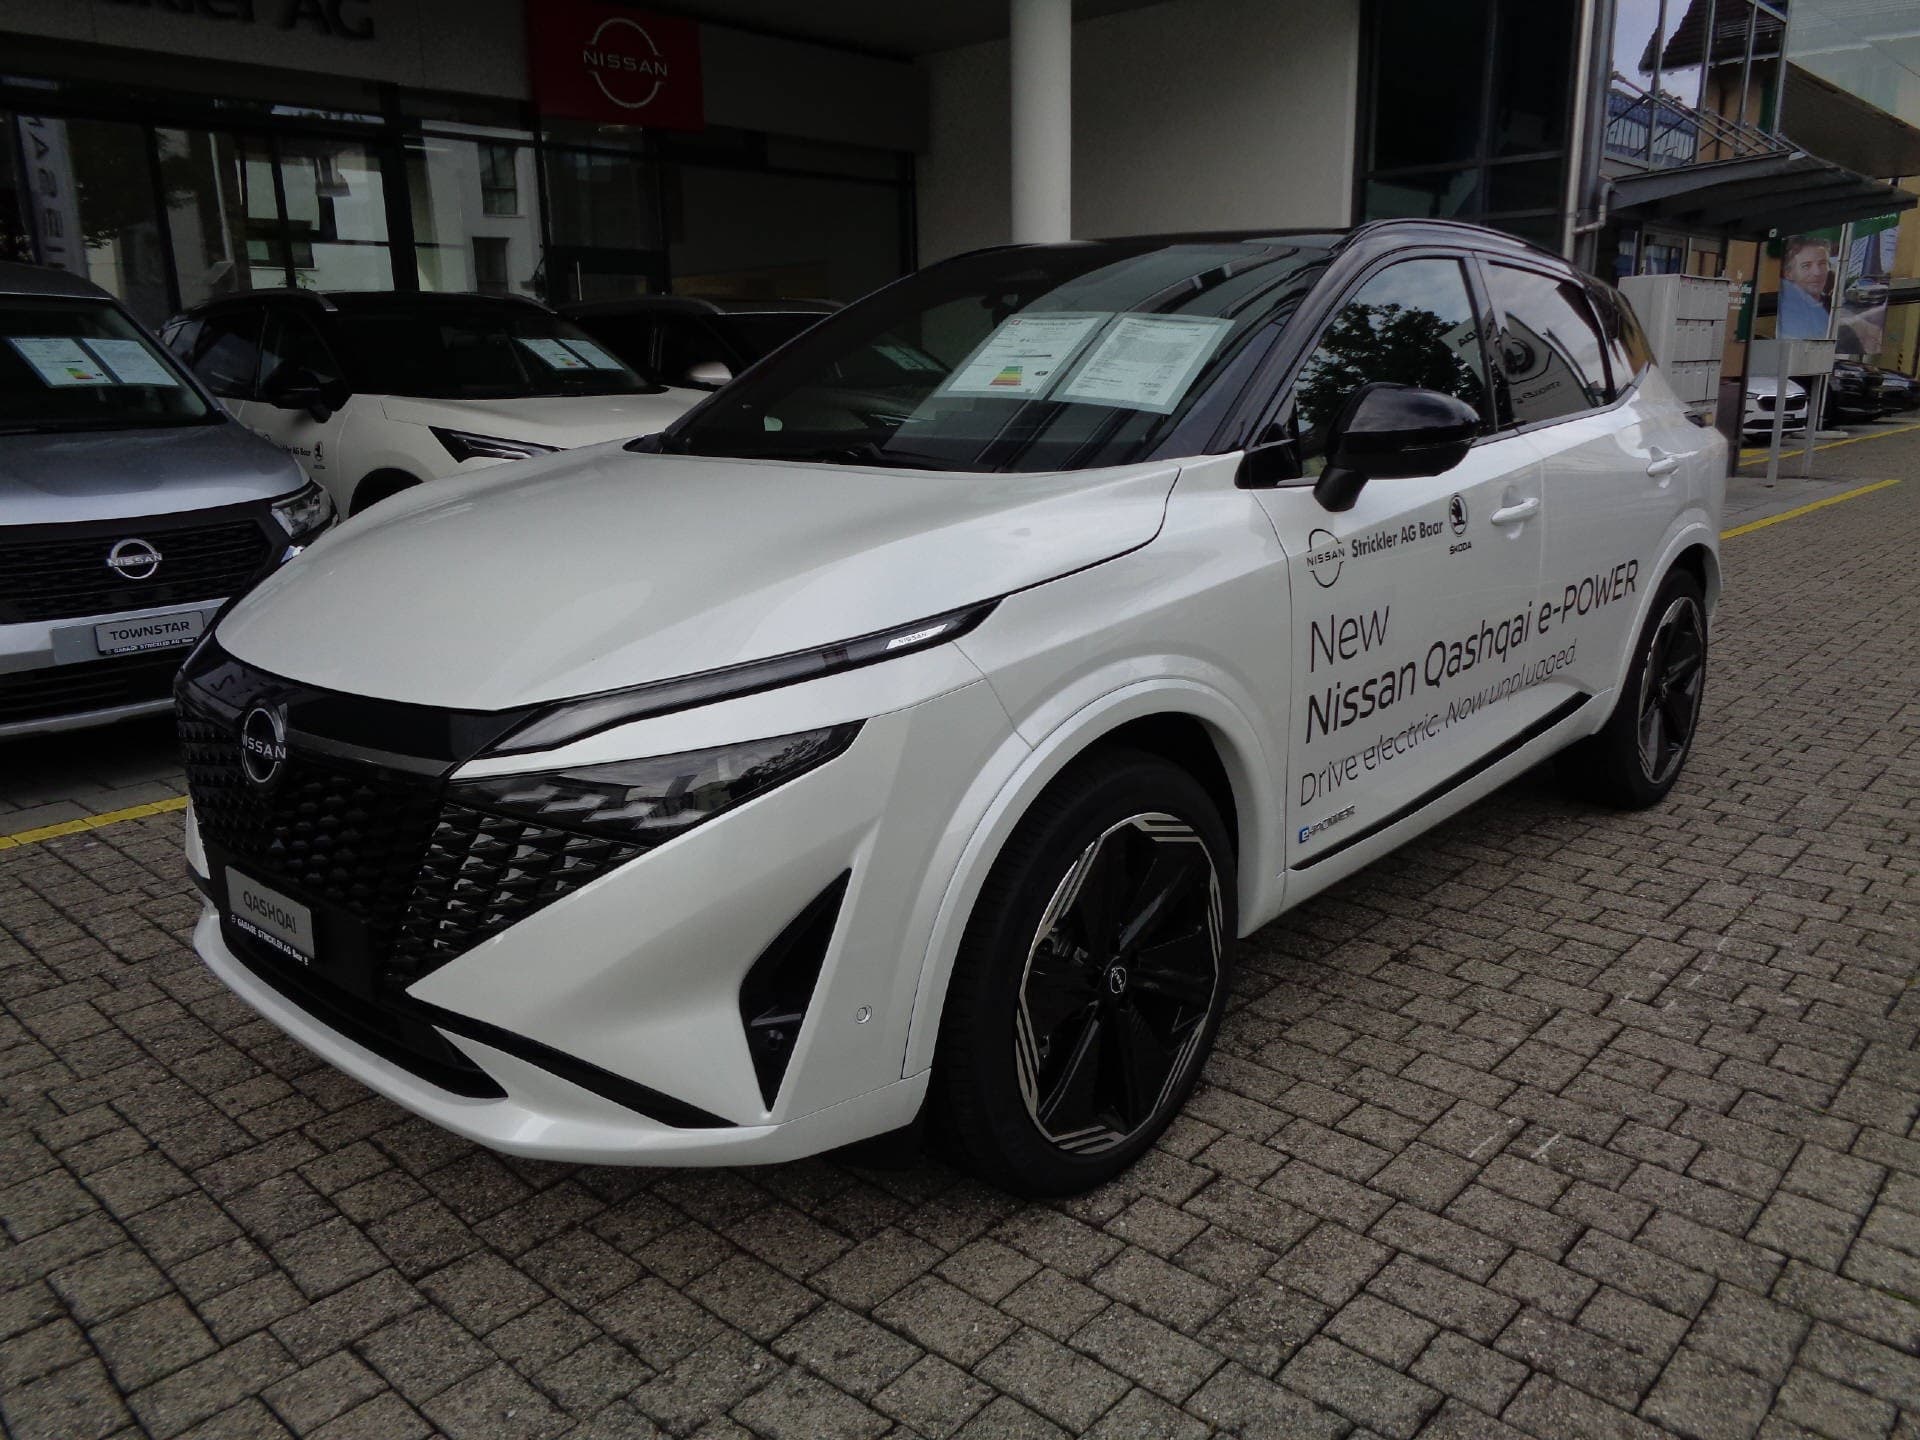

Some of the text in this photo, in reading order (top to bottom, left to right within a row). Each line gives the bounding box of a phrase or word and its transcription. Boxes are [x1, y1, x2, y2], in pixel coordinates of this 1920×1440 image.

[582, 48, 668, 77] NISSAN
[1351, 521, 1443, 557] Strickler AG Baar
[107, 552, 163, 567] NISSAN
[1306, 548, 1345, 567] NISSAN
[110, 621, 190, 640] TOWNSTAR
[1311, 605, 1390, 672] New
[1306, 559, 1639, 744] Nissan Qashqai e-POWER
[1300, 637, 1577, 807] Drive electric. Now unplugged.
[243, 890, 297, 935] QASHQAI
